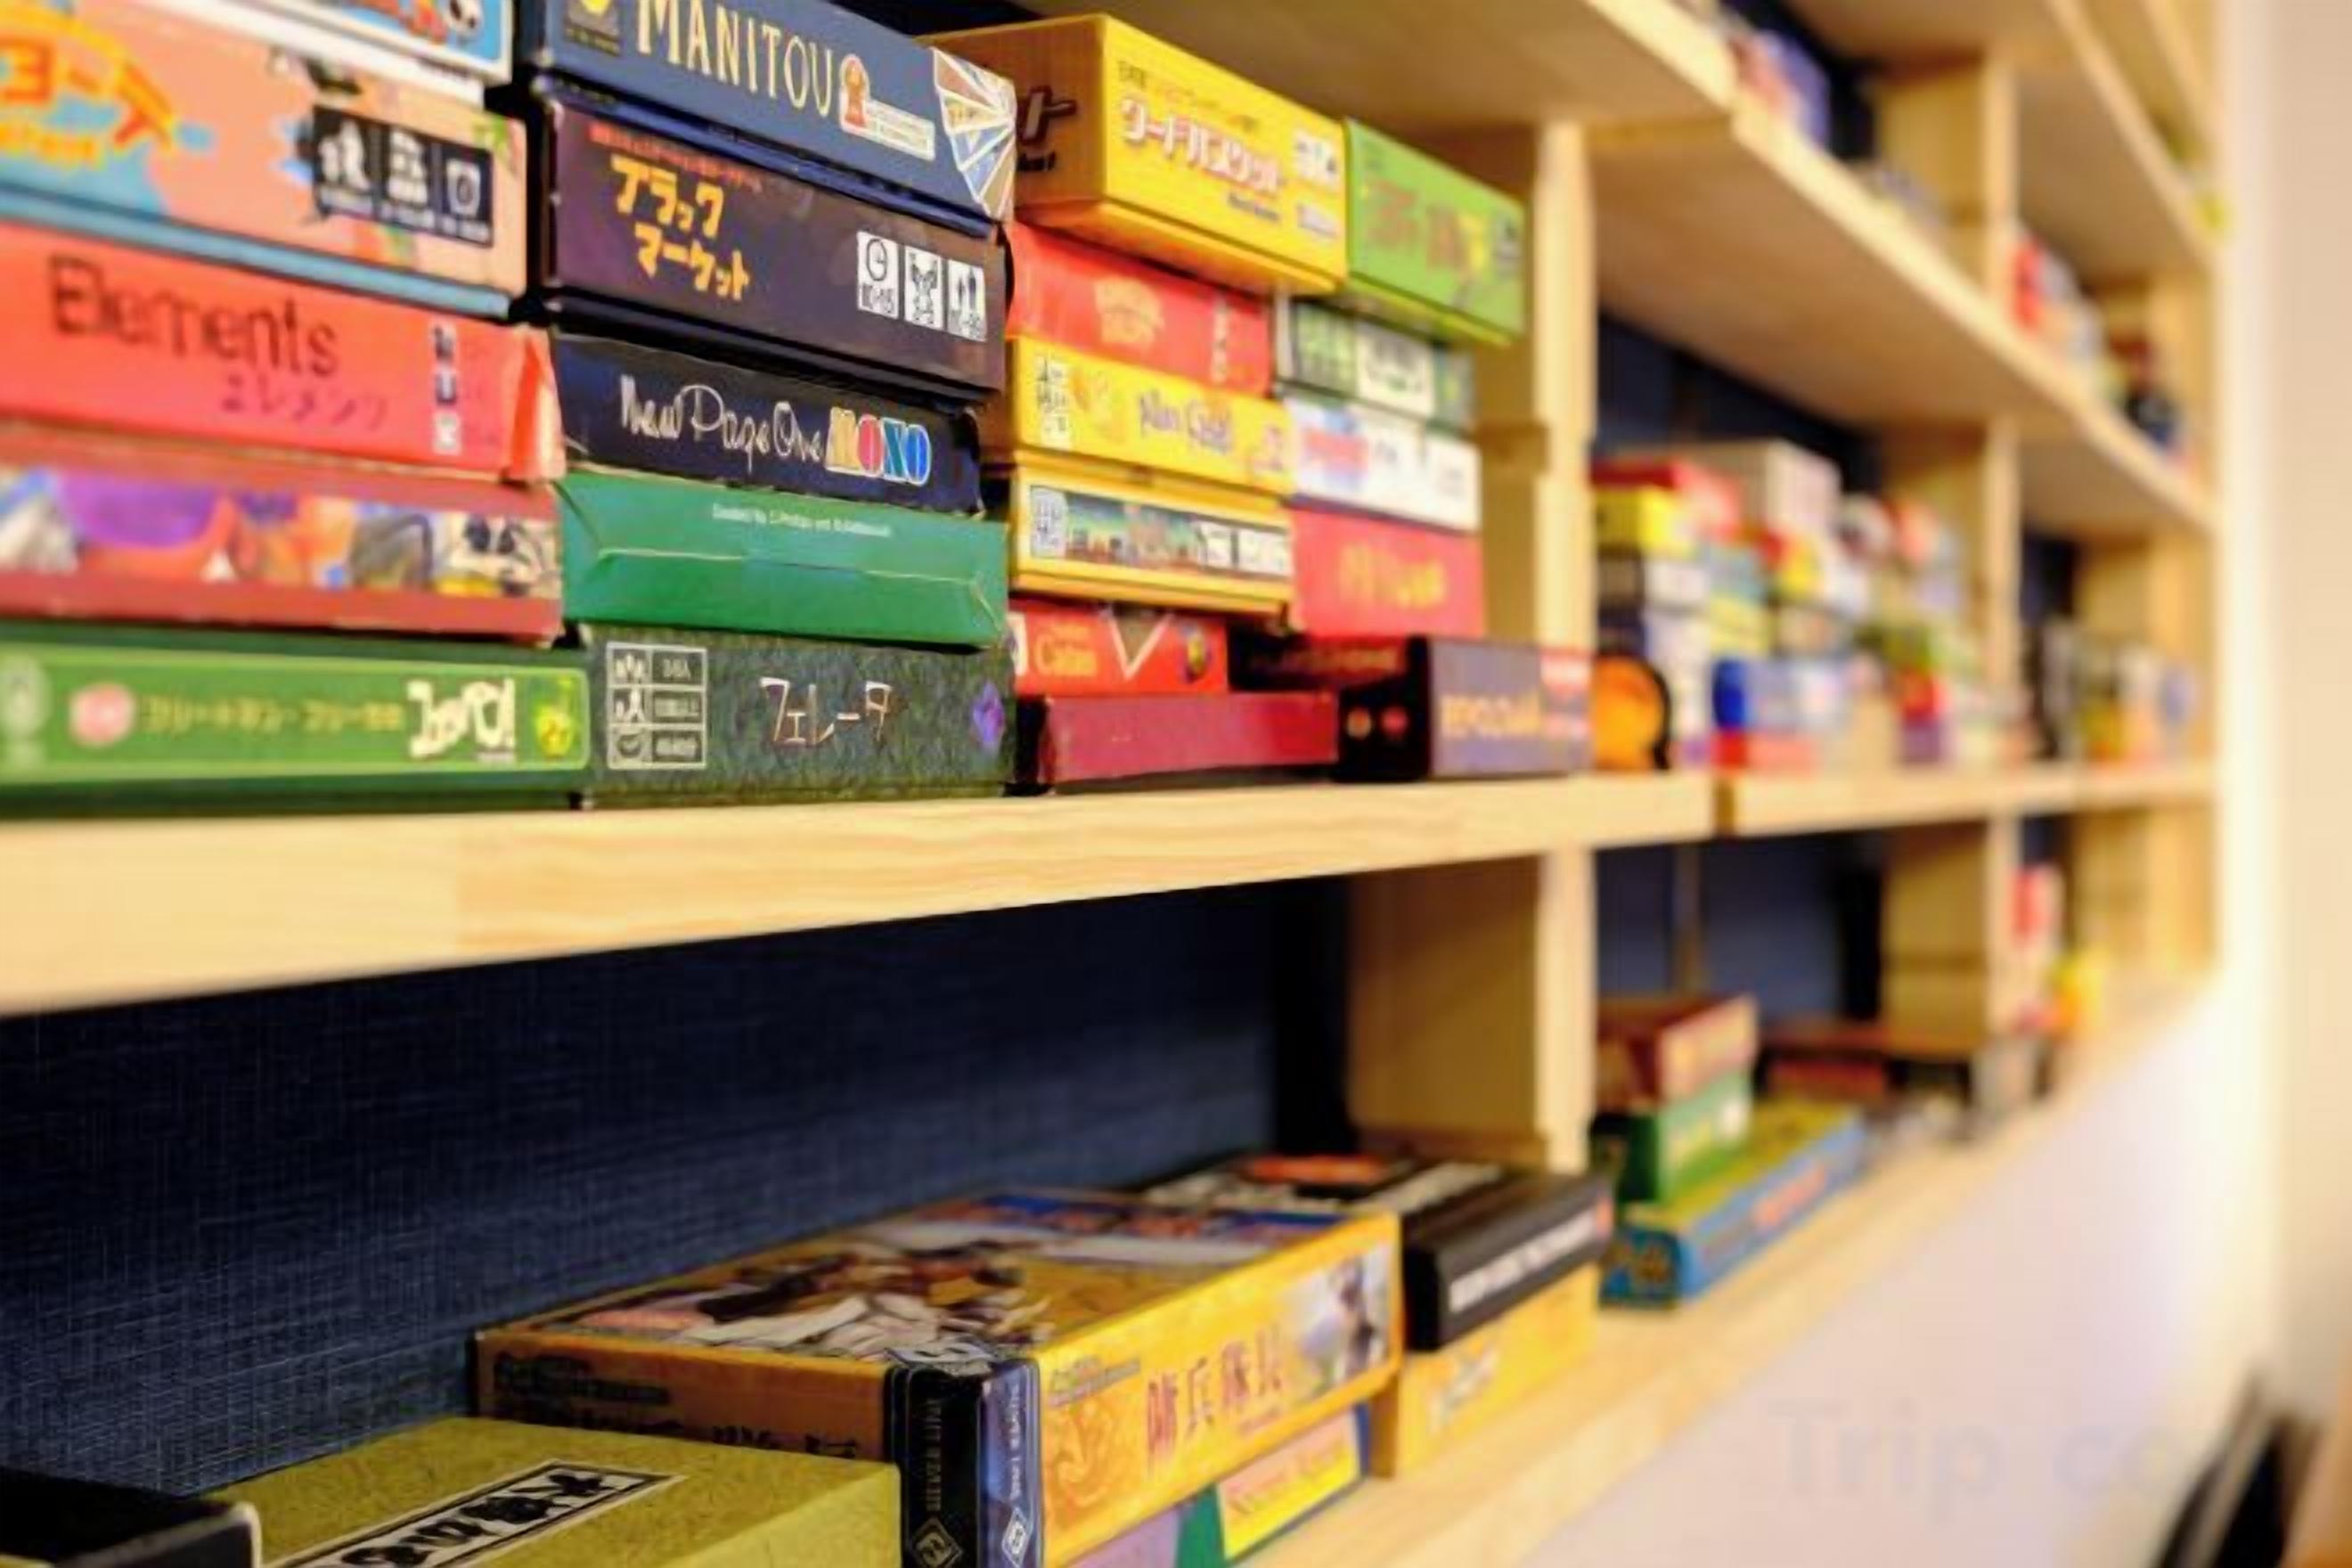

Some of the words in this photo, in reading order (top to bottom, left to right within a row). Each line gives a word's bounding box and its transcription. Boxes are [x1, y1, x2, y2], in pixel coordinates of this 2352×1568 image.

[635, 0, 833, 118] MANITOU
[634, 222, 750, 301] マーケット
[49, 255, 339, 378] Elements
[825, 405, 932, 487] MONO
